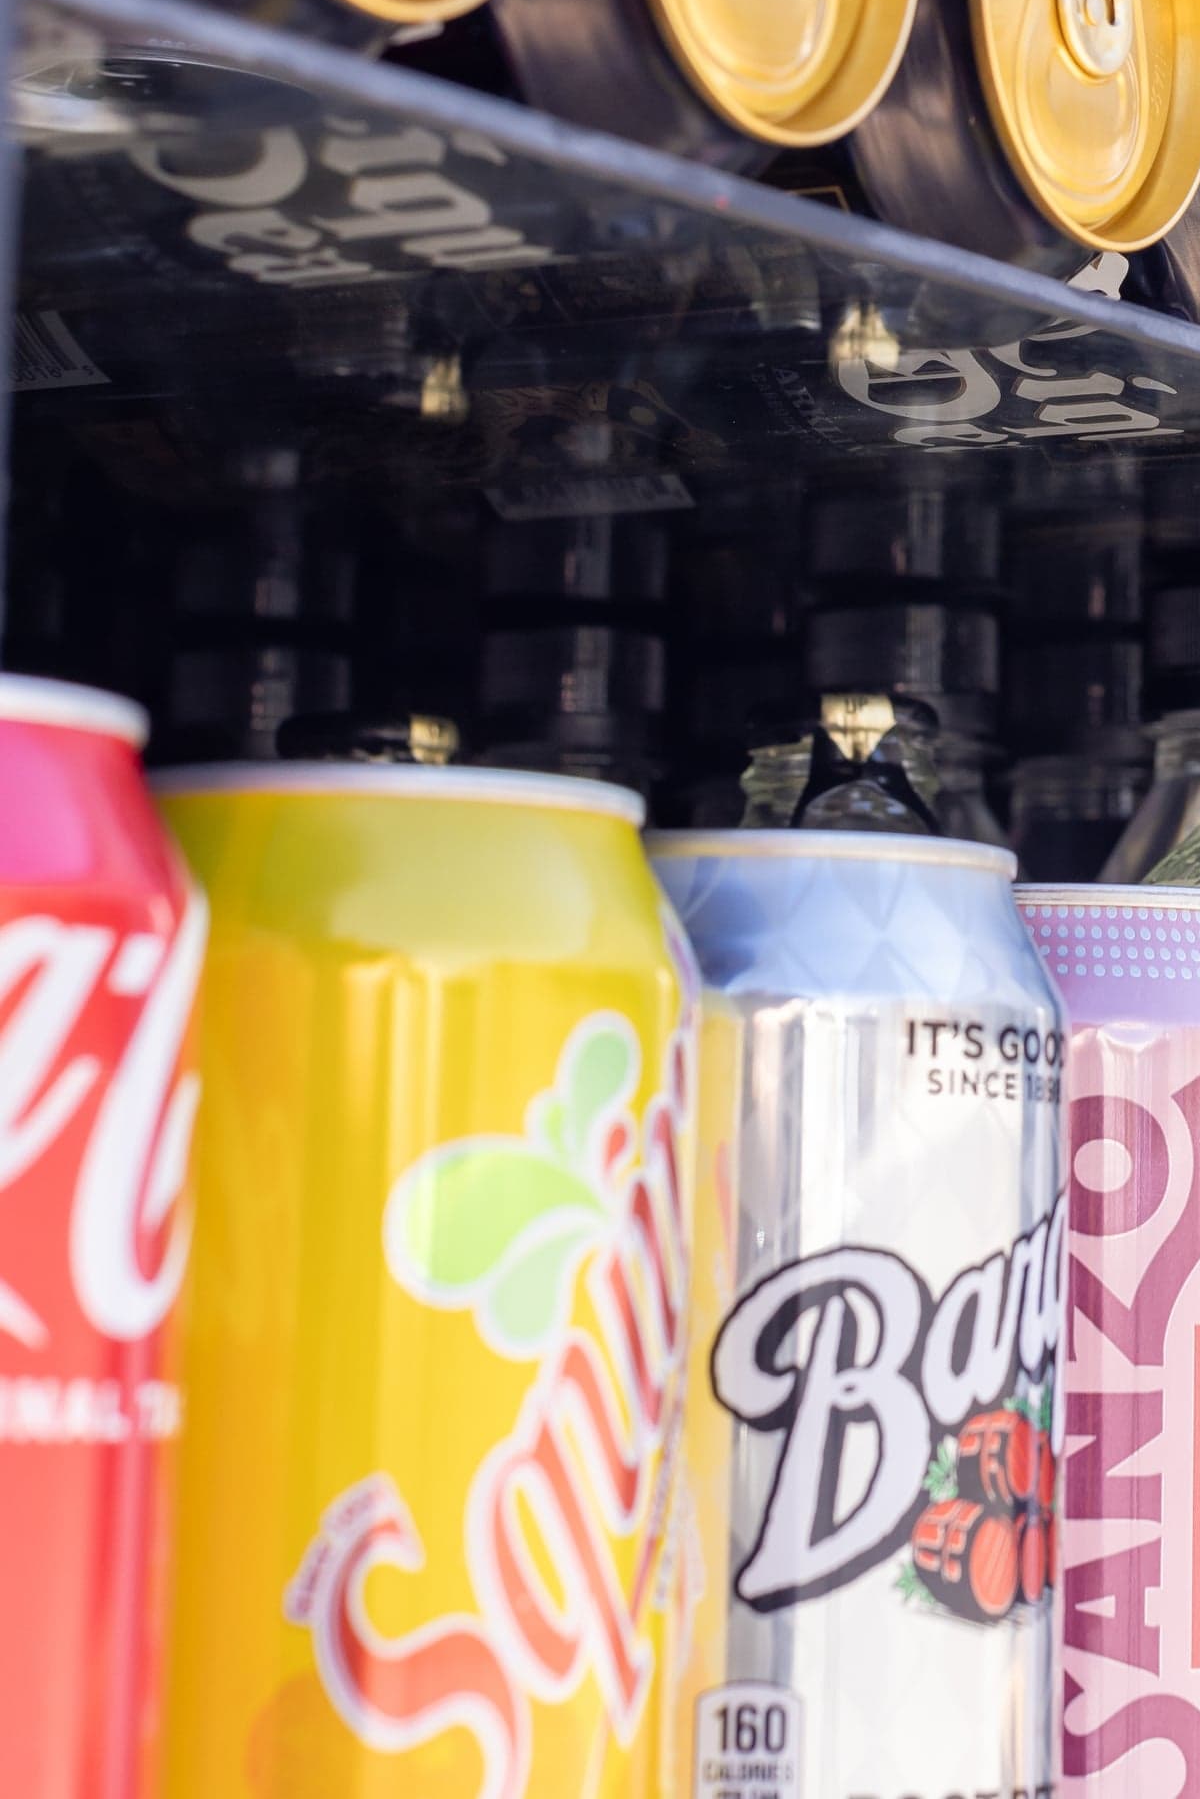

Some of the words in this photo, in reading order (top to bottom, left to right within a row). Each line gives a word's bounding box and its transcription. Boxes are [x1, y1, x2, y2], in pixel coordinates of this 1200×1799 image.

[907, 1020, 985, 1059] IT'S
[998, 1025, 1065, 1068] GOO
[928, 1069, 1016, 1100] SINCE
[714, 1703, 788, 1754] 160
